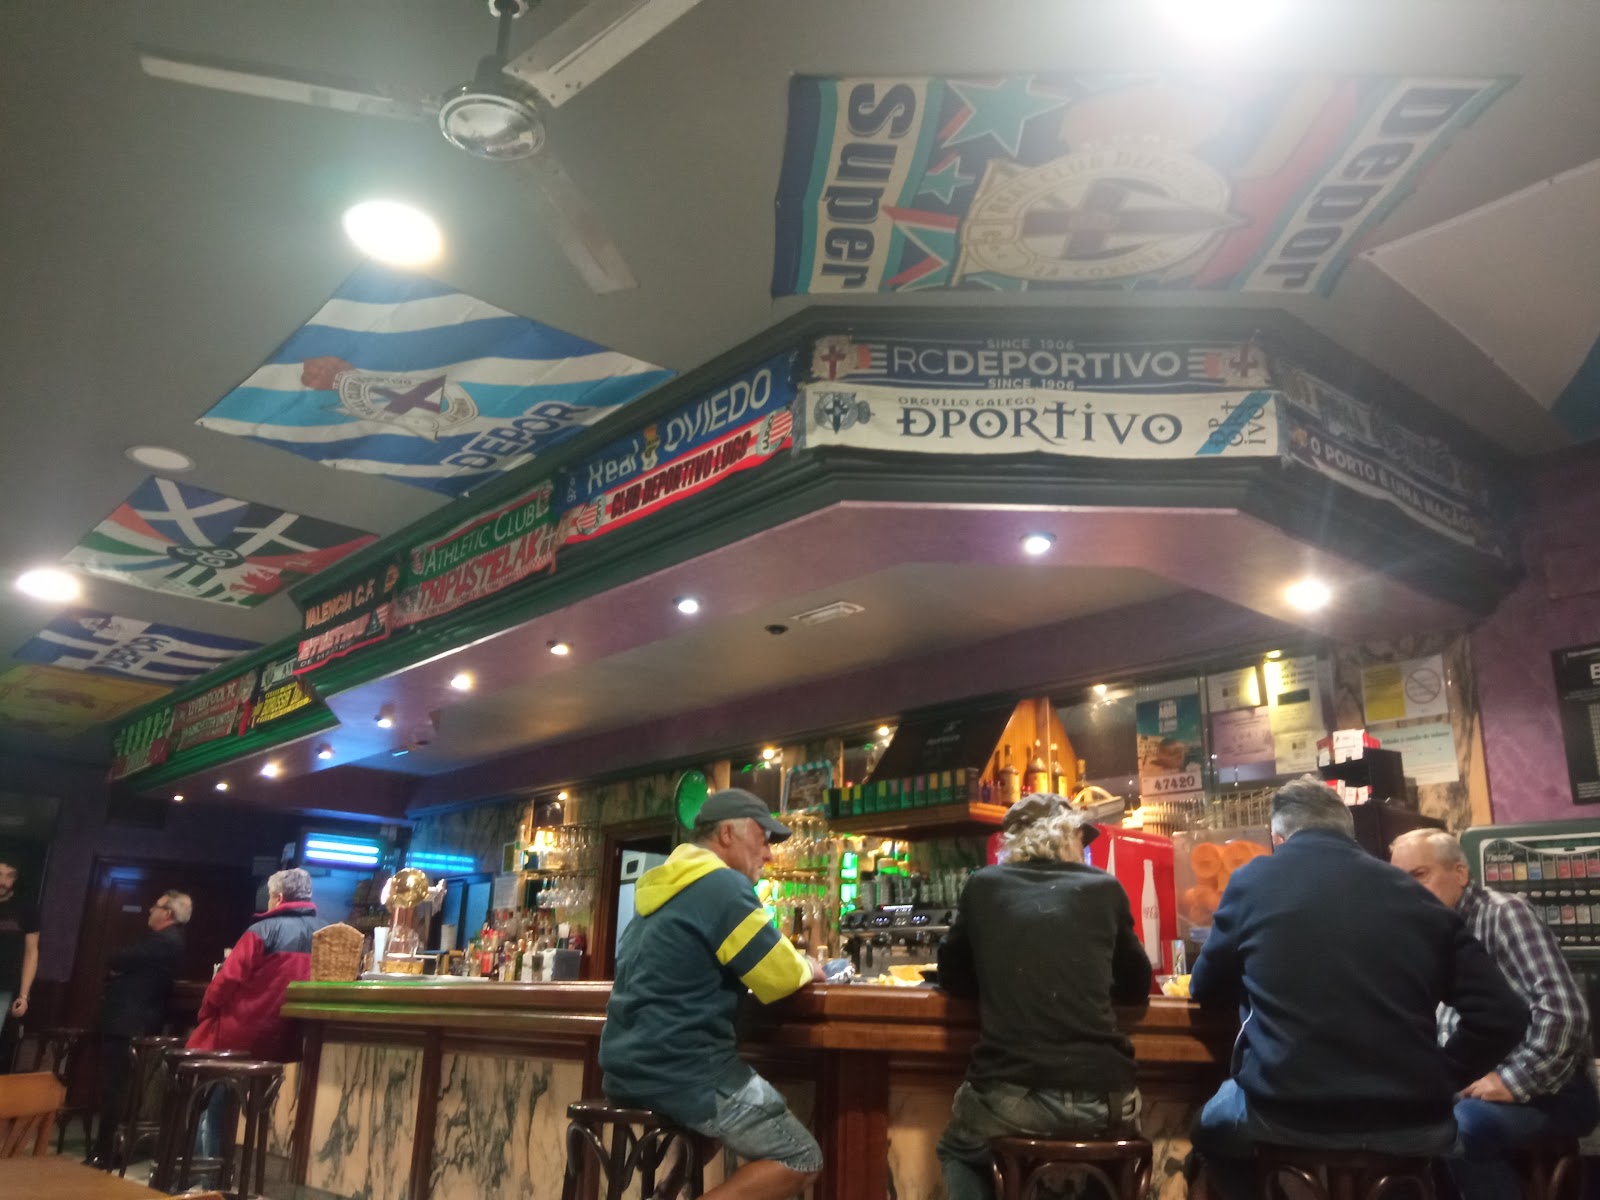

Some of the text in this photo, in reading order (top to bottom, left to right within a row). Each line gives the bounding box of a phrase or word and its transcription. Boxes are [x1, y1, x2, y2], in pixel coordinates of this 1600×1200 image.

[821, 83, 916, 289] Super
[1263, 86, 1482, 290] Depor
[986, 339, 1076, 351] SINCE 1906
[975, 396, 1037, 407] GALEGO
[987, 378, 1076, 391] SINCE 1906
[663, 368, 772, 452] OVIEDO
[446, 402, 590, 469] DEPOR
[641, 449, 715, 506] DEPORTIVO
[713, 430, 752, 475] LUGO
[1310, 436, 1321, 455] O
[1325, 443, 1376, 481] PORTO
[424, 505, 535, 576] ATHLETIC CLUB
[306, 590, 353, 630] VALENCIA
[300, 659, 313, 667] DE
[1154, 775, 1196, 791] 47420
